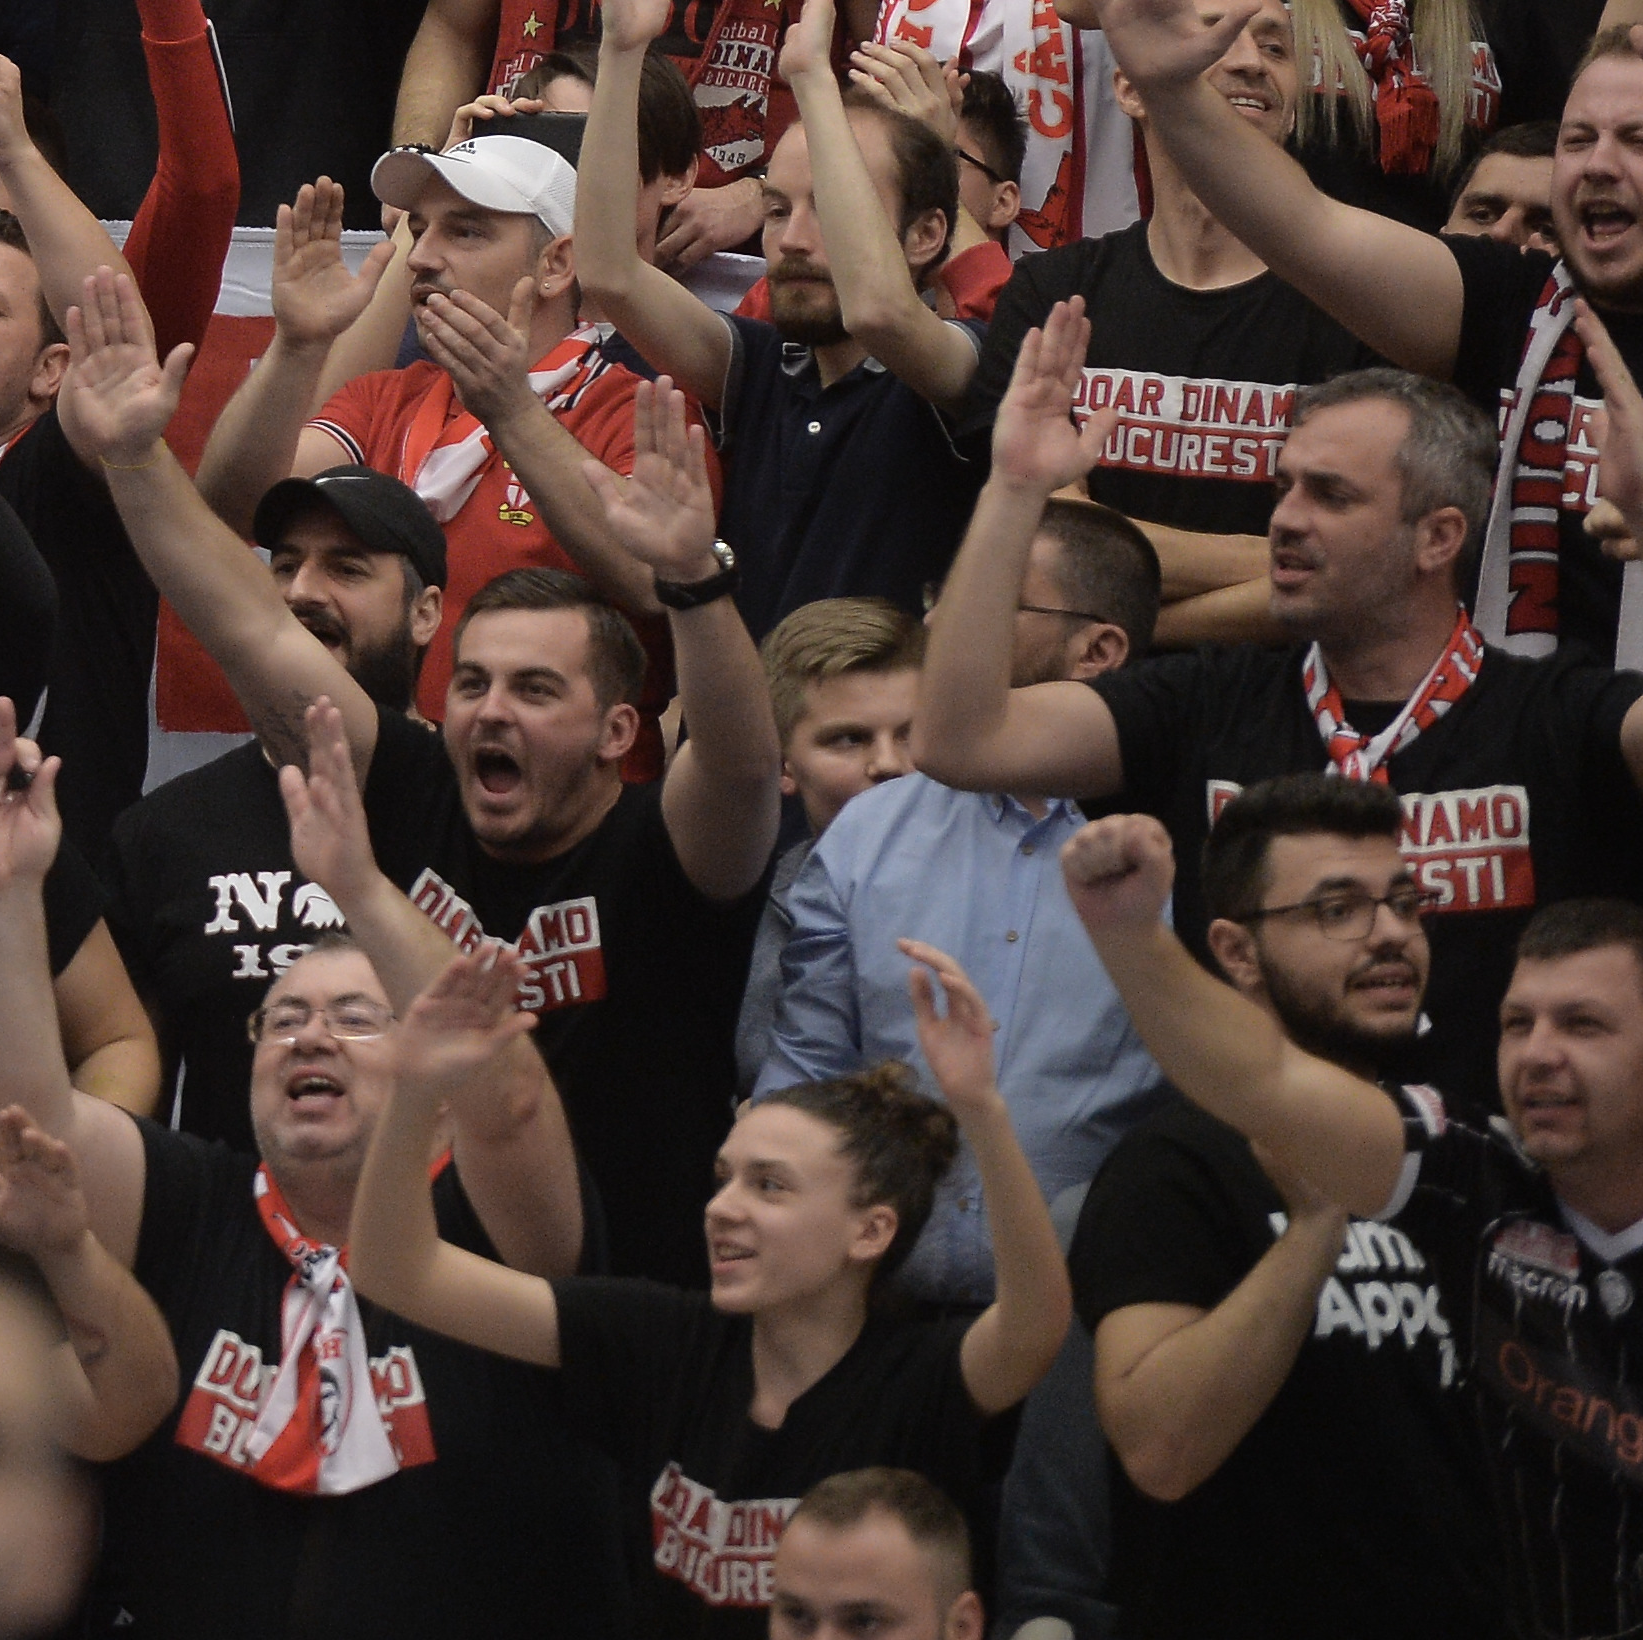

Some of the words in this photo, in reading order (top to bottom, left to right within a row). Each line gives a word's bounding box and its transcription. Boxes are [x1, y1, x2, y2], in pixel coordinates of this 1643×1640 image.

[1179, 383, 1297, 429] DINAM
[1099, 423, 1285, 478] UCUREST
[1498, 1340, 1643, 1466] Orang
